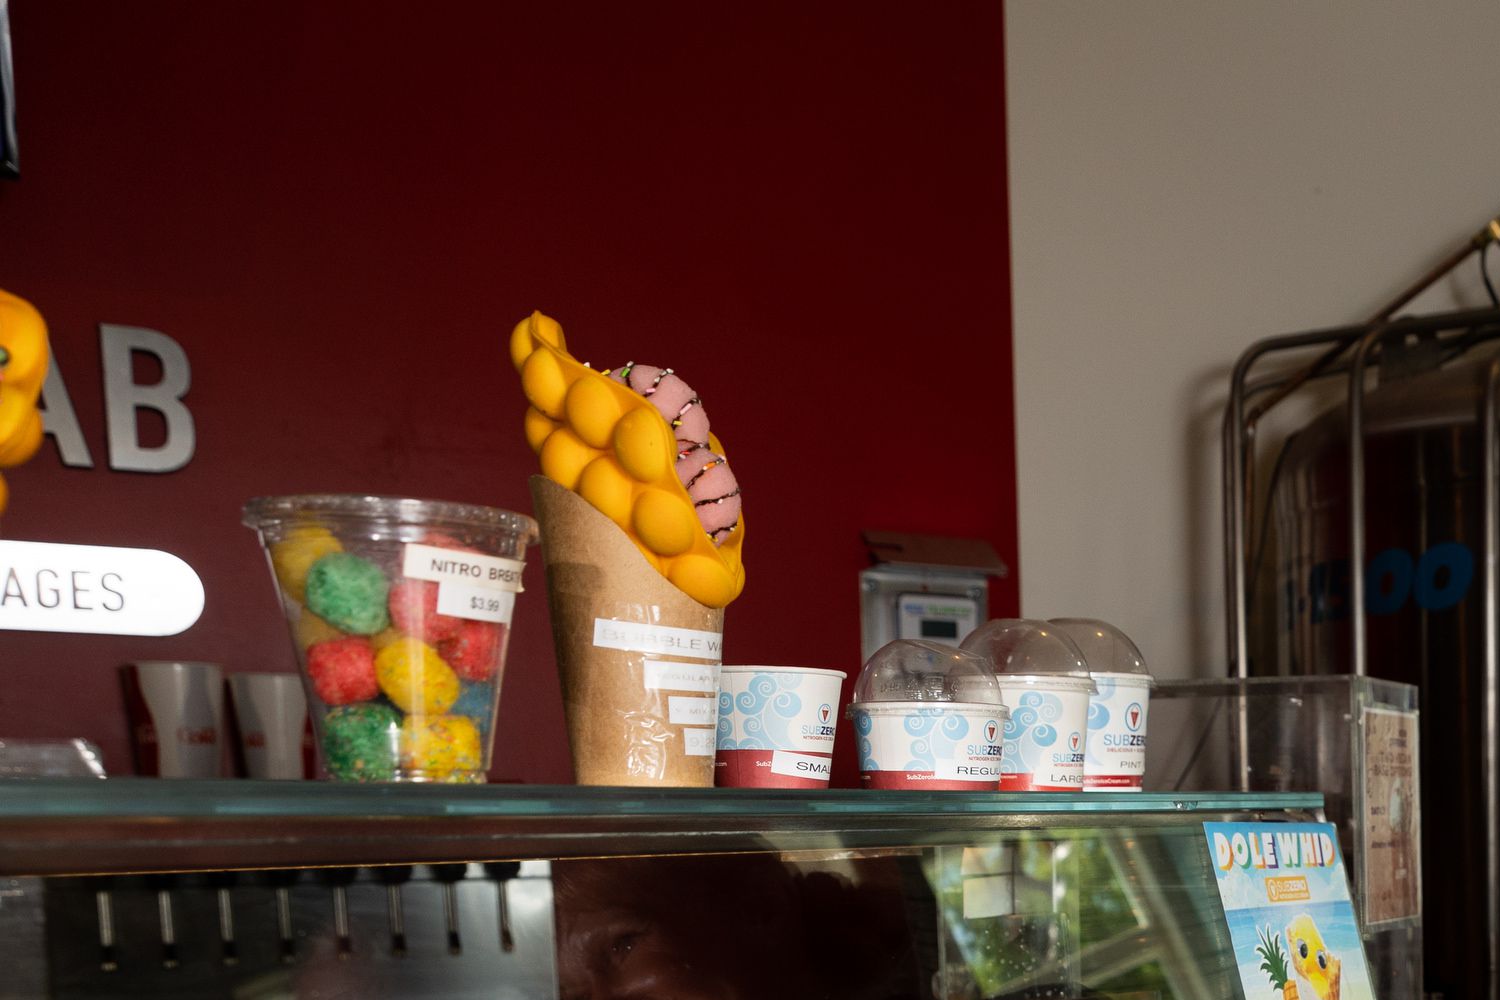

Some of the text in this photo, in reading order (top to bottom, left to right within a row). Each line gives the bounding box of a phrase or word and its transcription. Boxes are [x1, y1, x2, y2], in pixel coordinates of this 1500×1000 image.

[431, 559, 481, 577] NITRO
[707, 640, 721, 652] W
[796, 762, 832, 775] SMAL
[1119, 760, 1142, 769] PINT
[1050, 774, 1084, 783] LARG
[1213, 832, 1279, 871] DOLE
